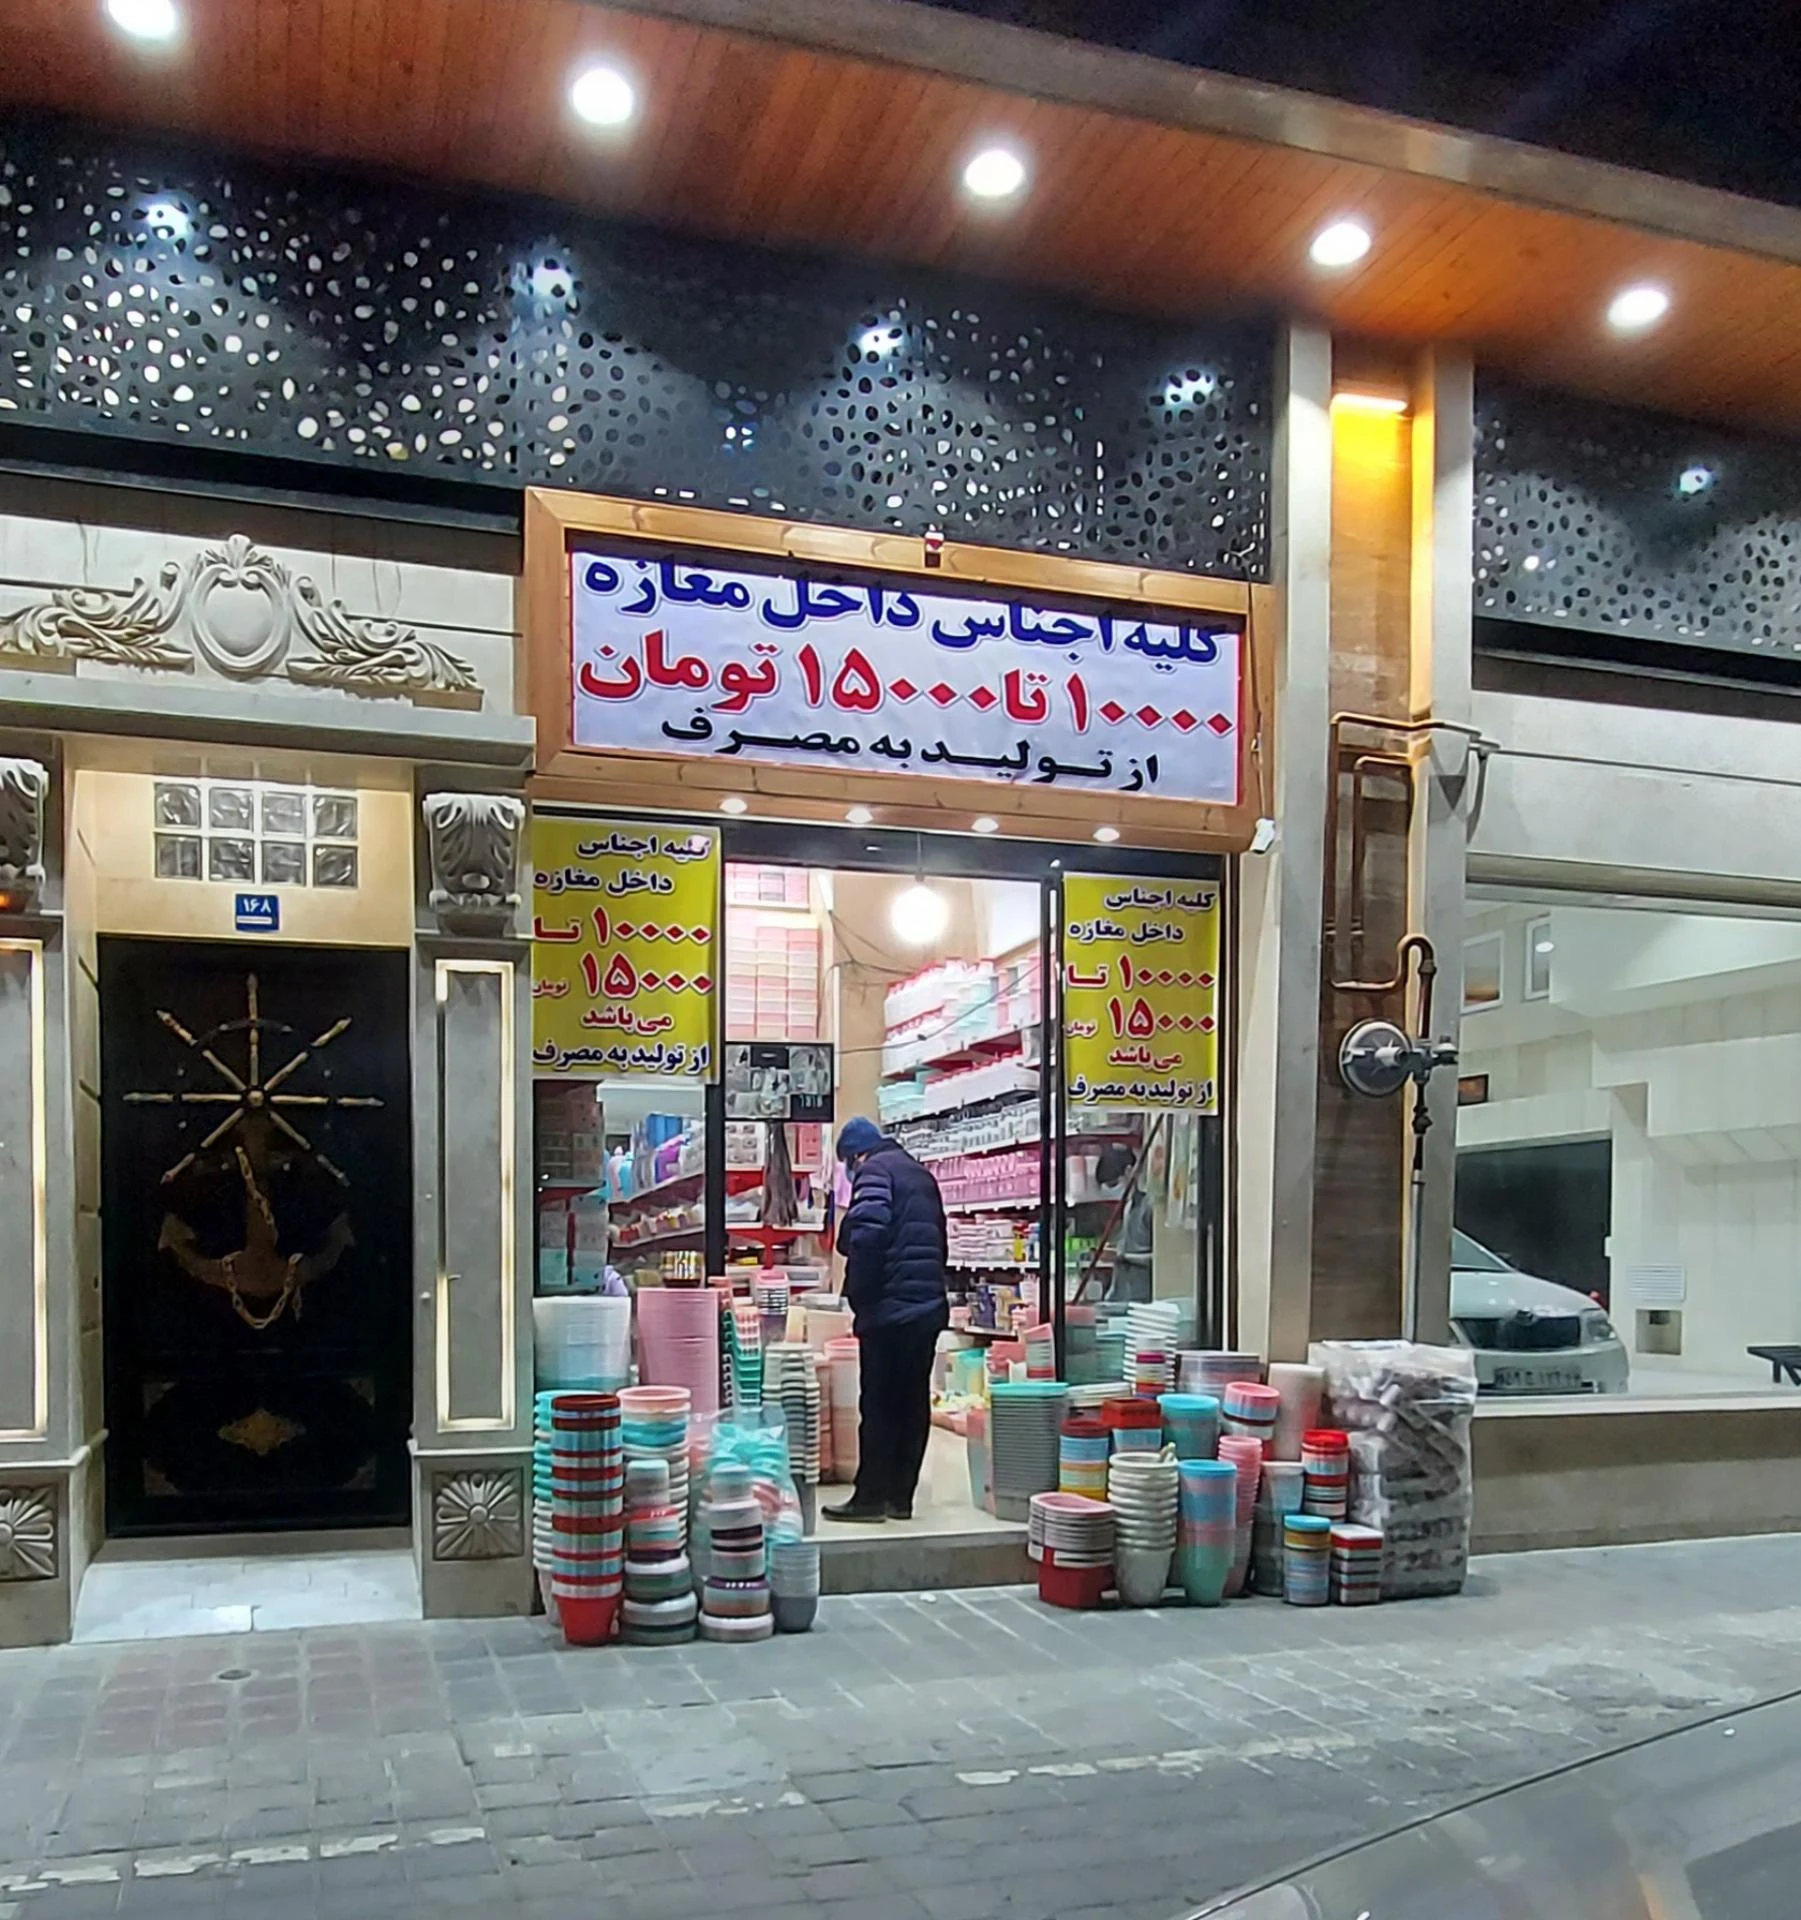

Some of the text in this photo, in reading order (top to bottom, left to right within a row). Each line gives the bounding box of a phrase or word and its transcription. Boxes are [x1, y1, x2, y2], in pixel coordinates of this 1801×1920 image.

[585, 554, 1225, 672] کلیه اجناس داخل مغازه
[580, 629, 1233, 736] ۱۰۰۰۰ تا ۱۵۰۰۰ تومان
[661, 706, 1158, 791] از تولید به مصرف
[578, 833, 657, 858] اجناس
[534, 868, 672, 893] داخل مغازه
[244, 898, 271, 912] ۱۶۸
[1106, 887, 1215, 914] کلیه اجناس
[534, 906, 709, 944] ۱۰۰۰۰ تا
[1069, 920, 1183, 943] داخل مغازه
[581, 952, 711, 996] ۱۵۰۰۰
[1068, 954, 1215, 988] ۱۰۰۰۰ تا
[582, 1005, 672, 1031] می باشد
[1109, 997, 1215, 1036] ۱۵۰۰۰
[532, 1039, 710, 1072] از تولید به مصرف
[1068, 1075, 1213, 1105] از تولید به مصرف
